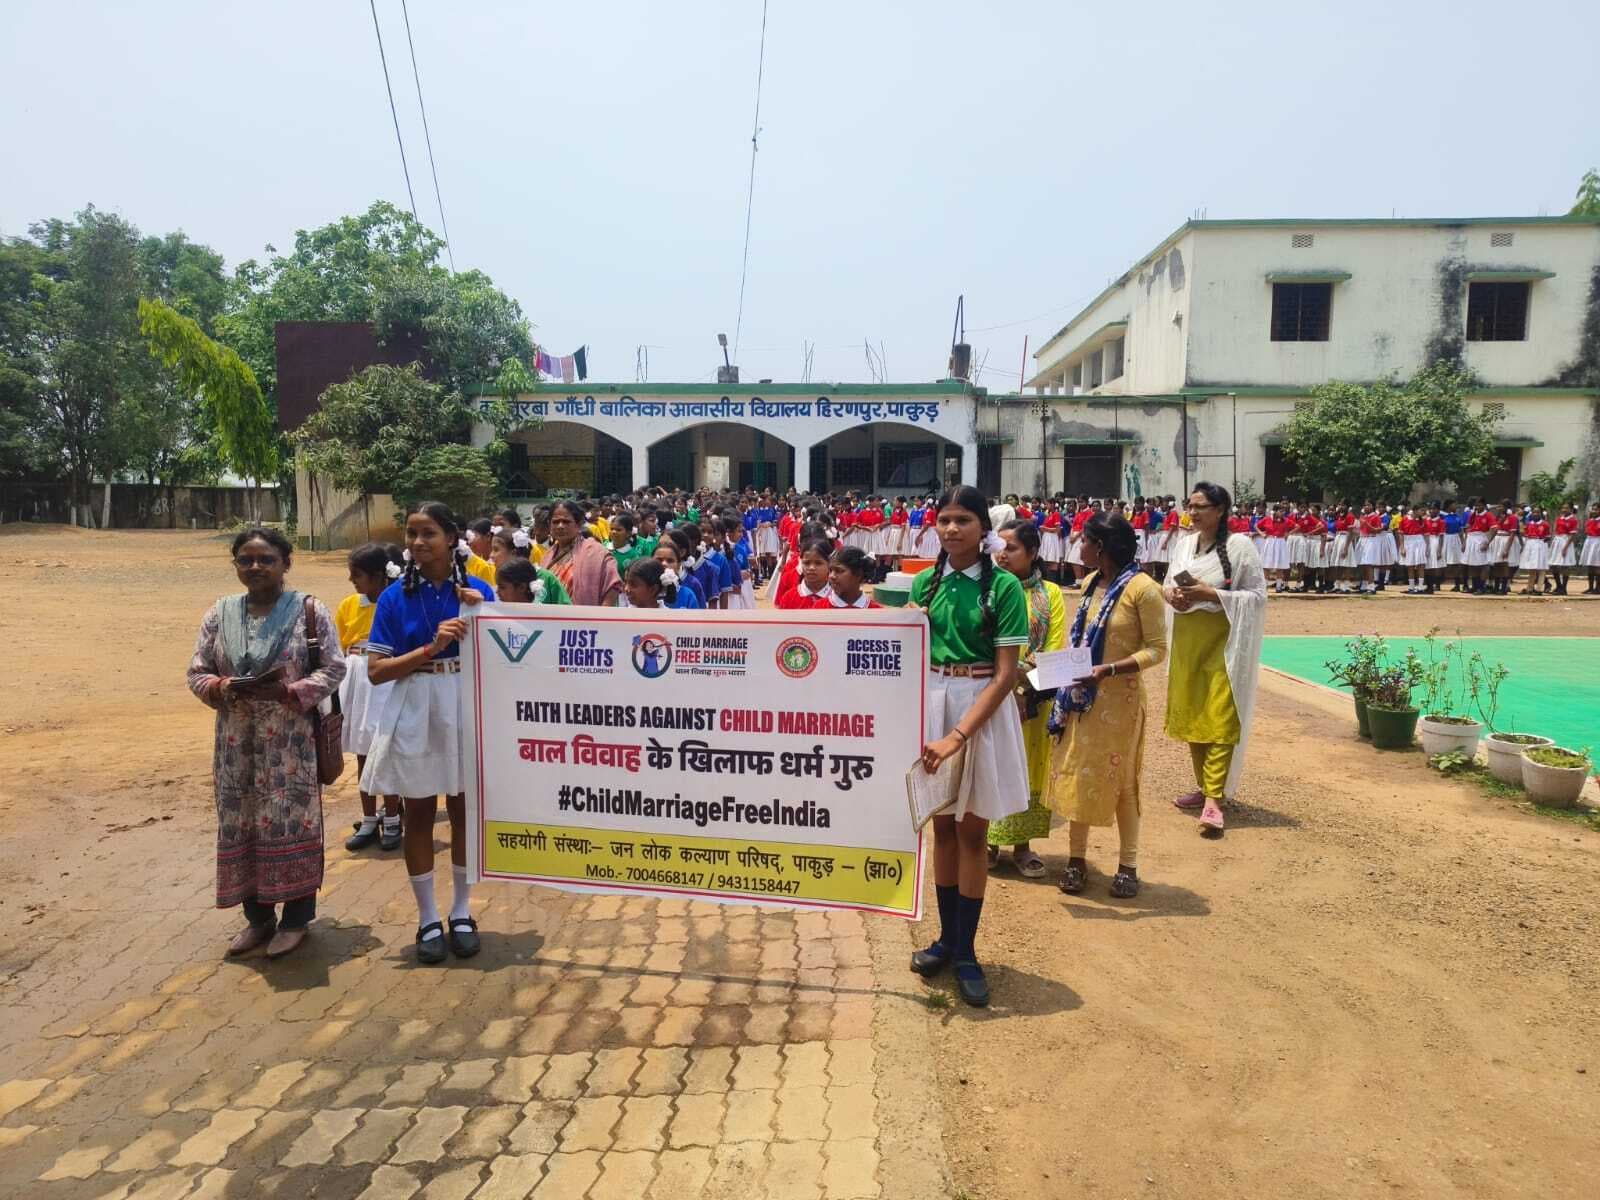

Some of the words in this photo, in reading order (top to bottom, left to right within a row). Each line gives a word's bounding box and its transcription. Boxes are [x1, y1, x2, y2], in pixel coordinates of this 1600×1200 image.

[554, 395, 596, 416] गाँधी
[600, 396, 667, 417] बालिका
[669, 396, 745, 417] आवासीय
[750, 397, 812, 418] विद्यालय
[560, 629, 598, 647] JUST
[676, 637, 700, 648] CHILD
[703, 637, 748, 649] MARRIAGE
[891, 644, 901, 653] TO
[559, 648, 613, 667] RIGHTS
[675, 650, 701, 663] FREE
[704, 651, 747, 664] BHARAT
[845, 653, 901, 675] JUSTICE
[516, 700, 561, 723] FAITH
[565, 703, 636, 727] LEADERS
[640, 706, 716, 731] AGAINST
[720, 709, 773, 734] CHILD
[778, 712, 875, 738] MARRIAGE
[518, 738, 566, 764] बाल
[572, 734, 641, 773] विवाह
[647, 737, 673, 771] के
[678, 739, 774, 775] खिलाफ
[780, 745, 824, 778] धर्म
[830, 753, 874, 791] गुरु
[558, 785, 831, 828] #ChildMarriageFreeIndia
[497, 829, 547, 851] सहयोगी
[610, 841, 635, 858] जन
[640, 838, 672, 861] लोक
[679, 847, 730, 866] कल्याण
[792, 855, 835, 879] पाकुड़
[626, 867, 704, 887] 7004668147
[707, 872, 715, 889] /
[717, 874, 800, 894] 9431158447
